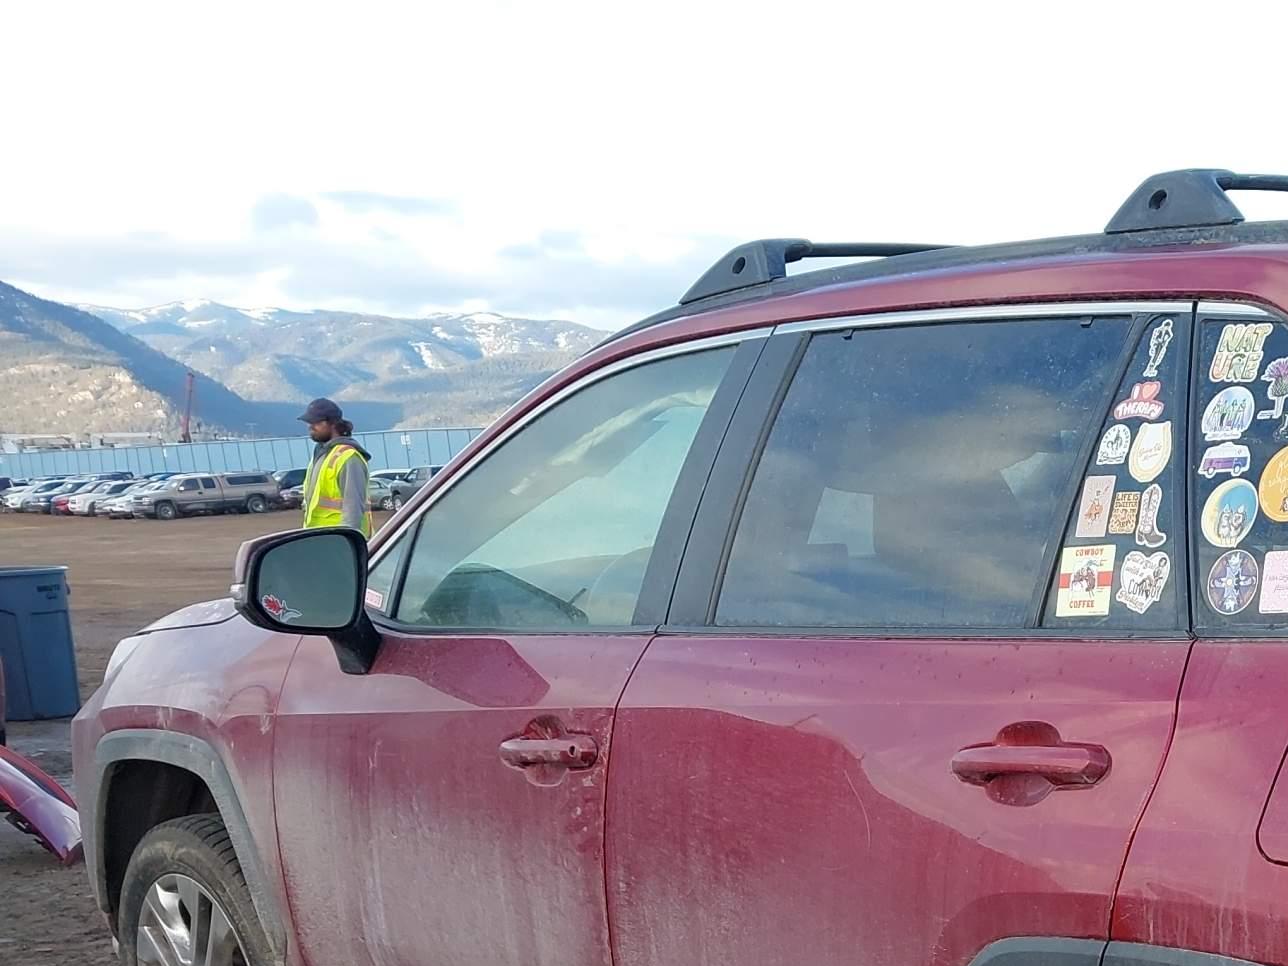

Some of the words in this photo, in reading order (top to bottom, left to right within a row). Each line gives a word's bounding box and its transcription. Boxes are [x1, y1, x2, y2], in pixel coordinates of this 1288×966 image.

[1116, 401, 1161, 418] THERAPY
[1075, 548, 1104, 557] COWBOY
[1069, 600, 1095, 609] COFFEE
